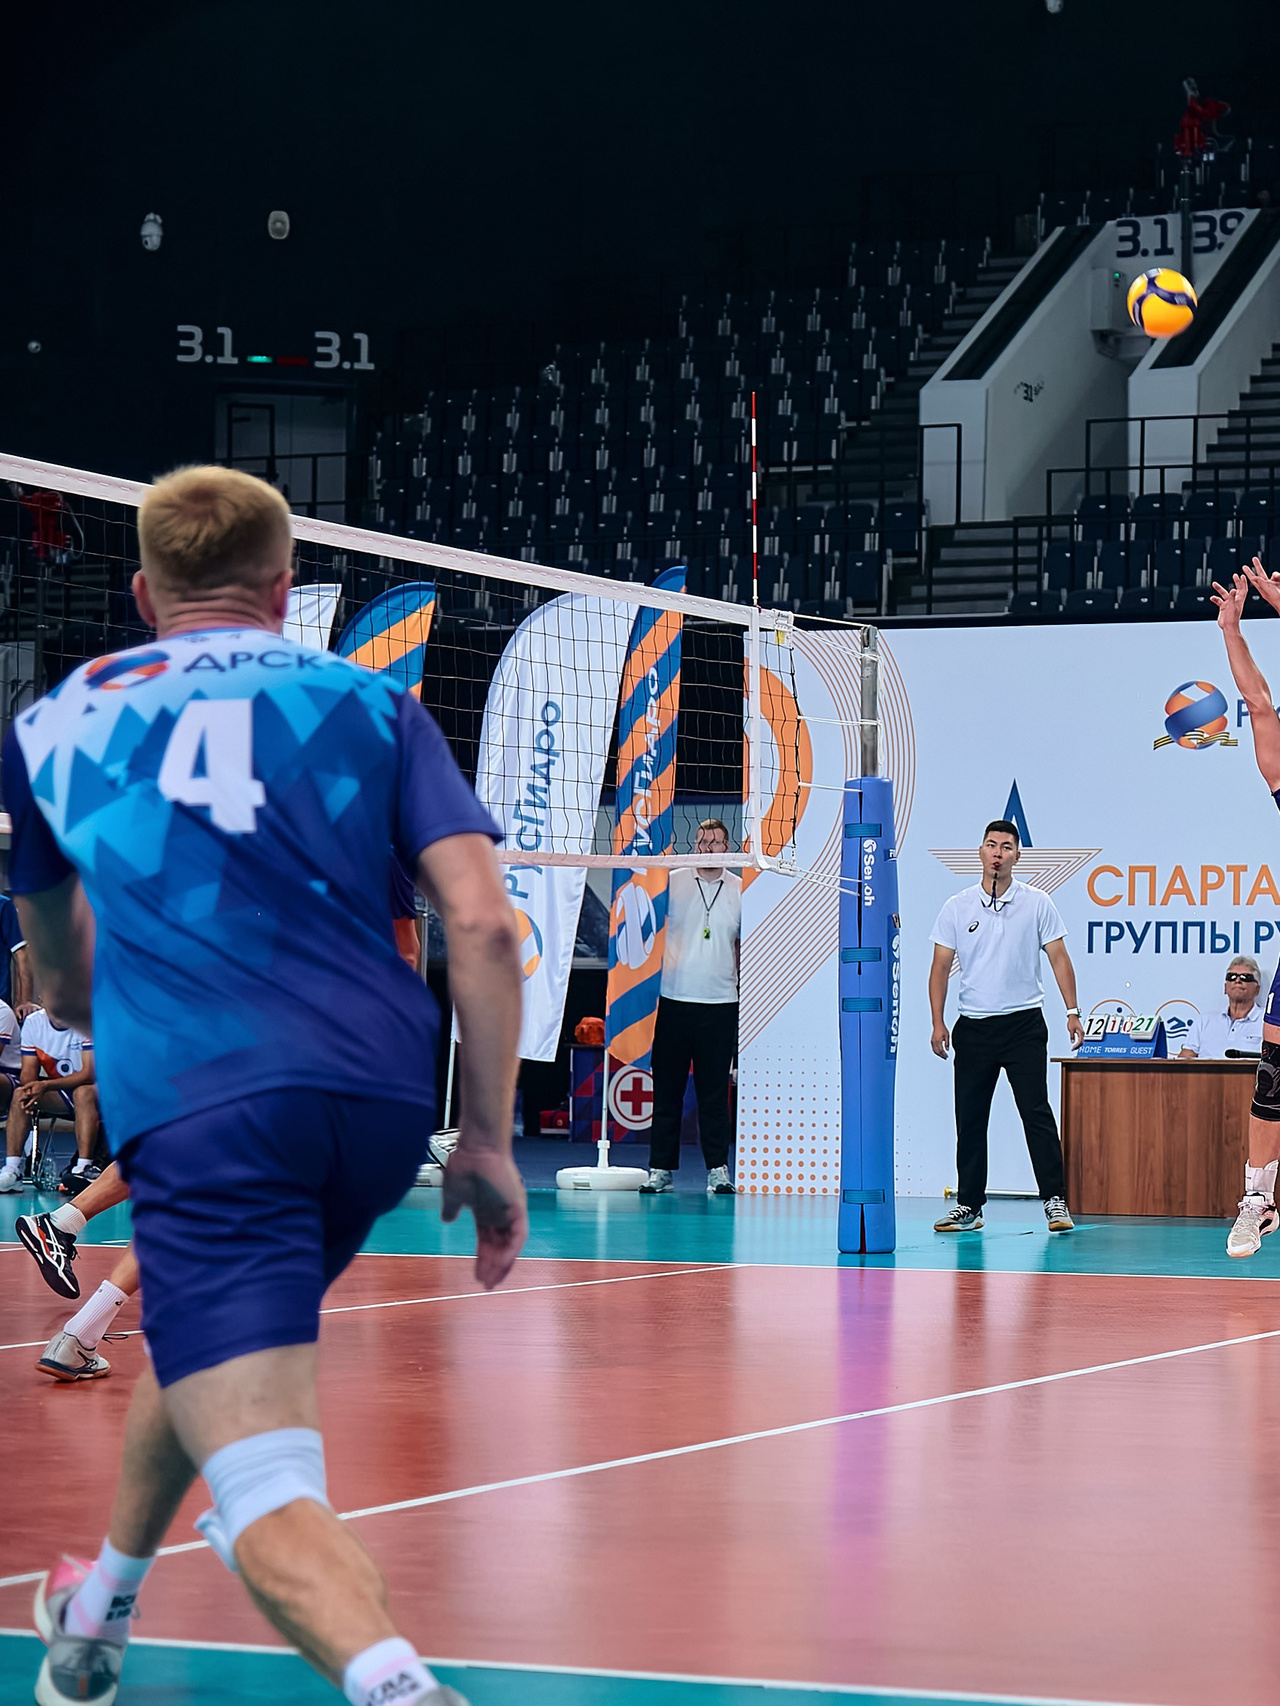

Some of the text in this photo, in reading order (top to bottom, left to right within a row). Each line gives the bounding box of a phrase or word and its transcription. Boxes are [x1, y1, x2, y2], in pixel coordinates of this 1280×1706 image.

[1115, 218, 1175, 259] 3.1
[176, 325, 239, 365] 3.1
[314, 331, 375, 370] 3.1
[157, 698, 267, 834] 4
[1087, 920, 1241, 954] ГРУППЫ
[1266, 992, 1275, 1014] 1
[1085, 1018, 1105, 1036] 12
[1132, 1017, 1155, 1031] 21
[1079, 1045, 1154, 1055] HOME TORRES GUEST
